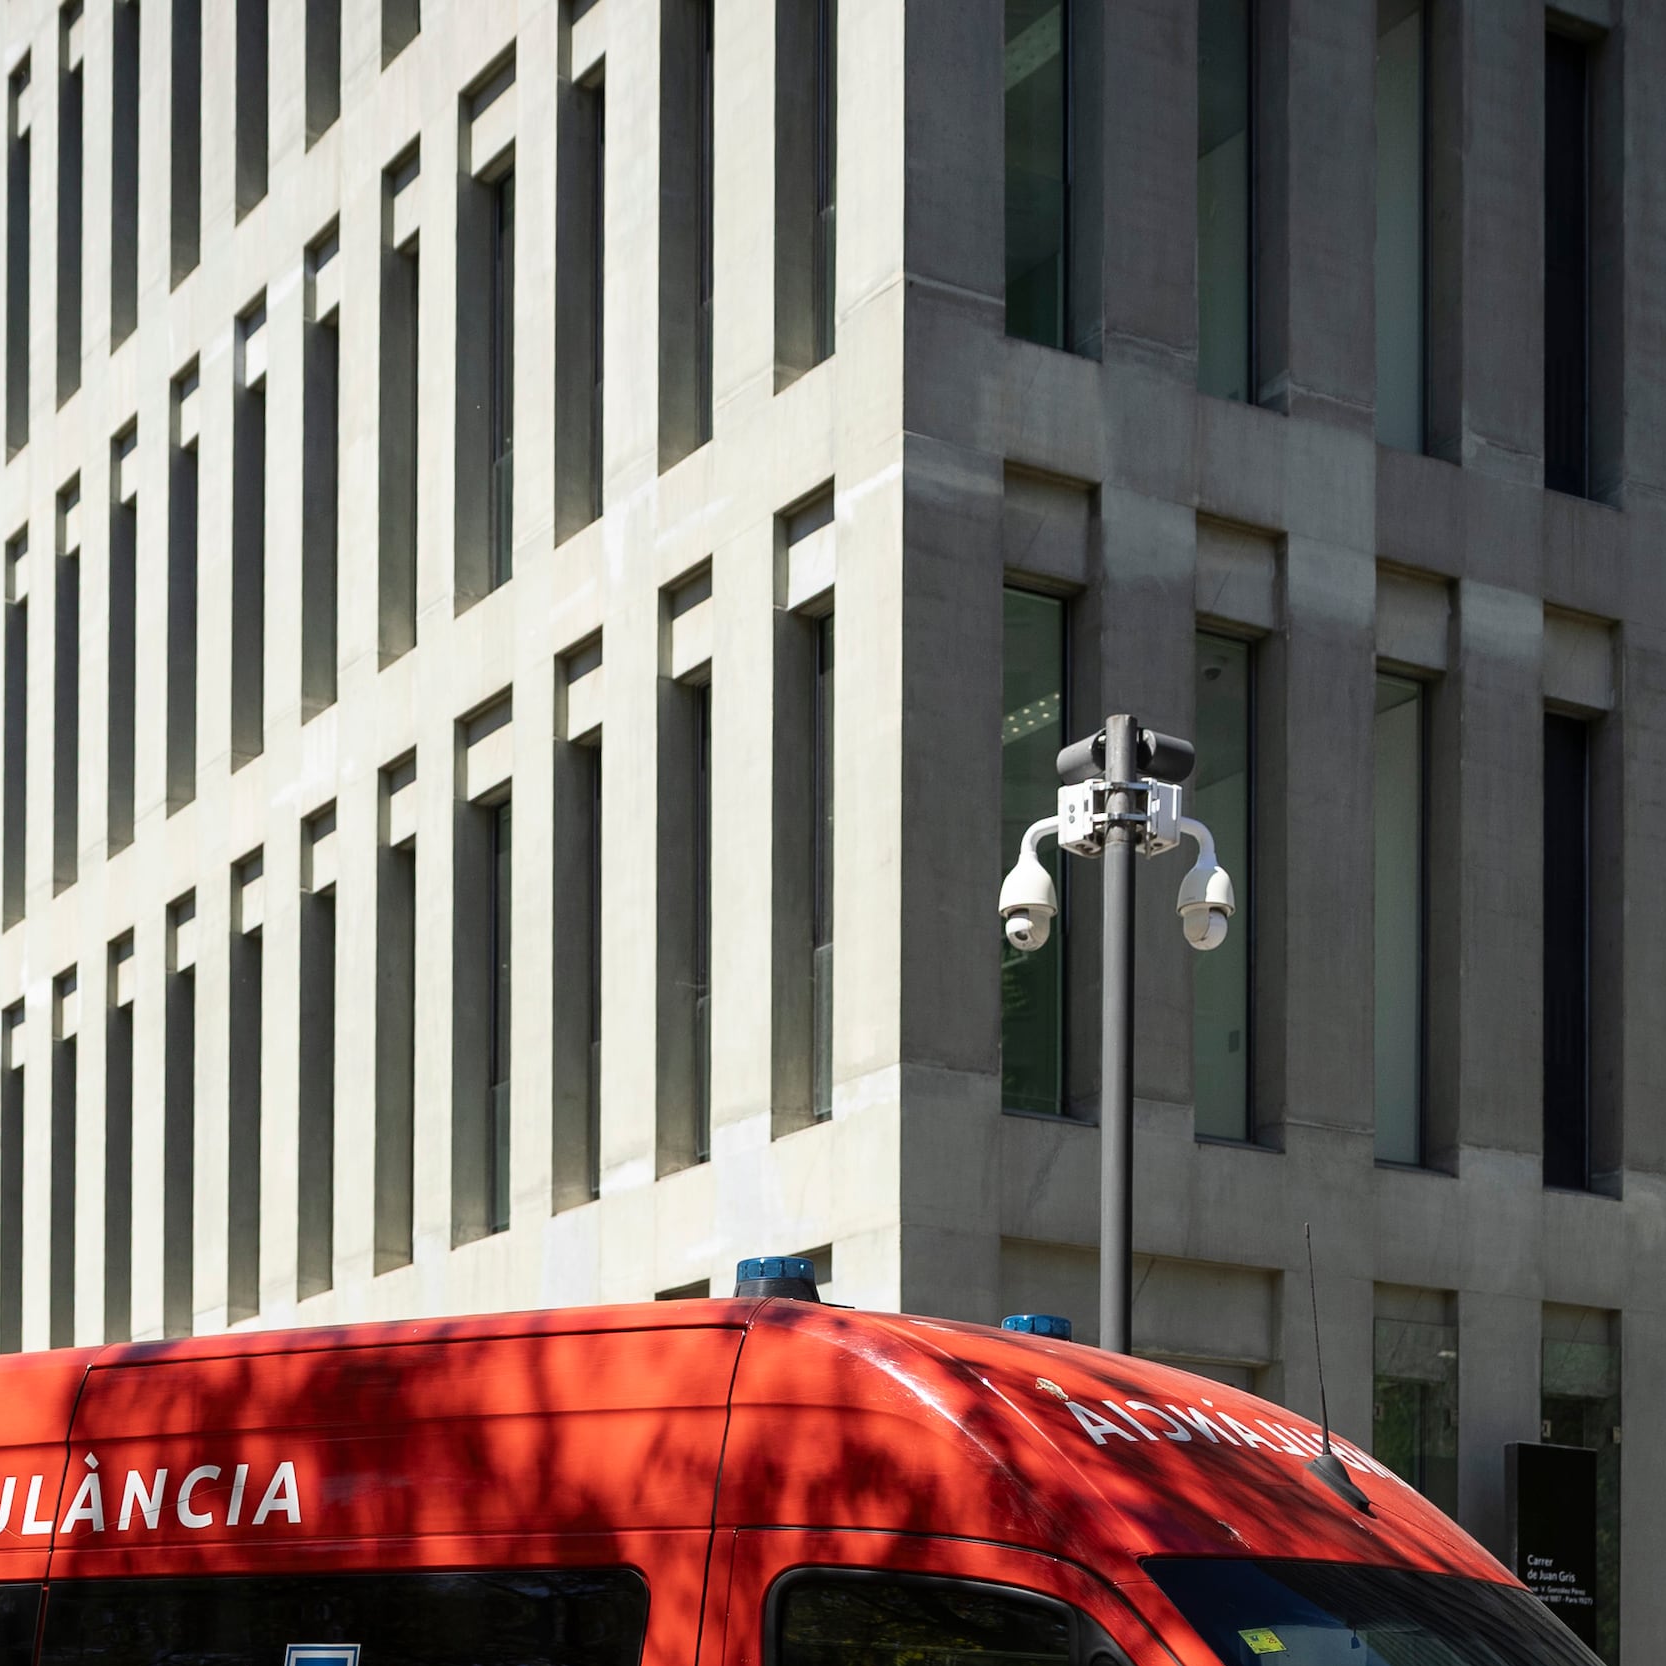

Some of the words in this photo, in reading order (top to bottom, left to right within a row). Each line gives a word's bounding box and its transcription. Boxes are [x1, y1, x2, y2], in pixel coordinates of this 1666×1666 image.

[1527, 1554, 1554, 1567] Carrer
[1527, 1569, 1538, 1579] de
[1539, 1569, 1557, 1581] Juan
[1558, 1571, 1576, 1583] Gris
